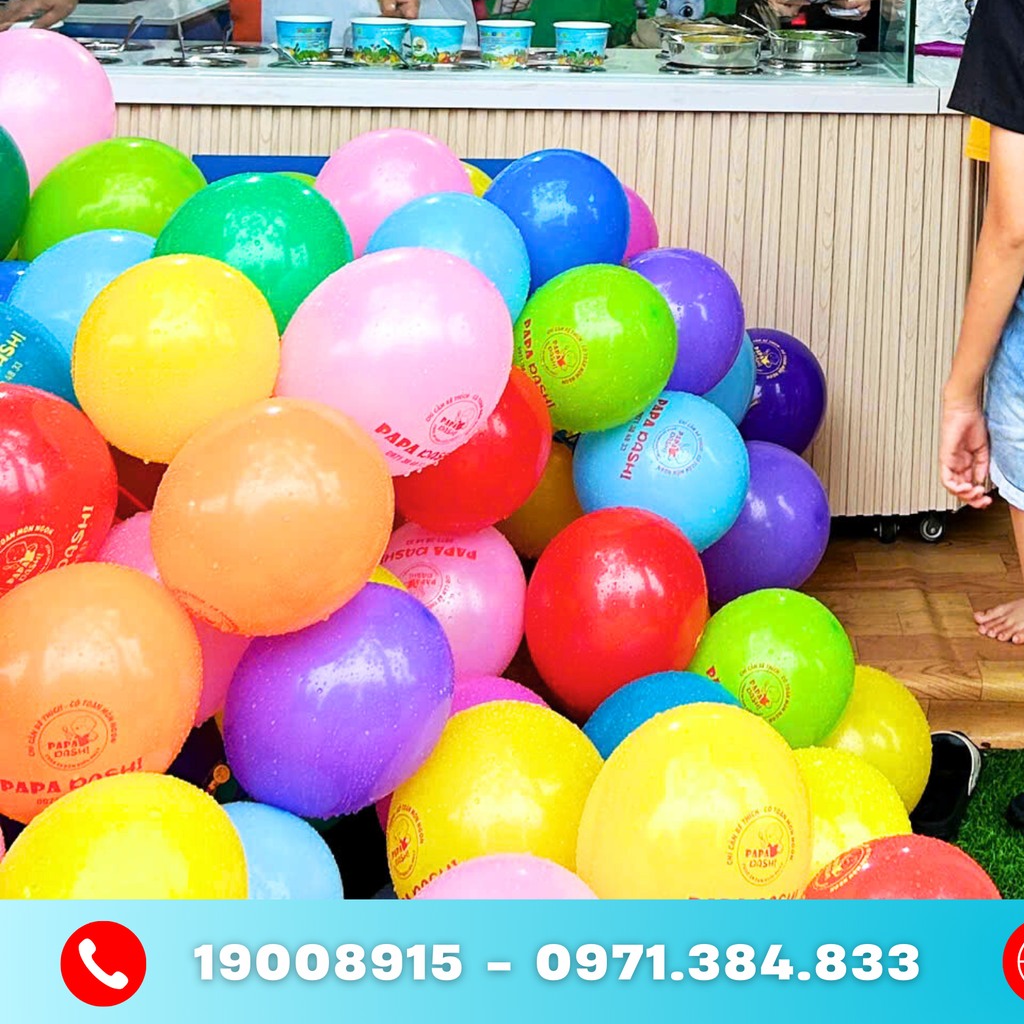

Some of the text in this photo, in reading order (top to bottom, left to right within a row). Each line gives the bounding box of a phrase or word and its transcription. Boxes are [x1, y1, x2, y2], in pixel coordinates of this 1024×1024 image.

[375, 422, 420, 455] PAPA
[620, 399, 669, 480] PAPA DASHI
[434, 546, 477, 560] PAPA
[47, 740, 78, 750] PAPA
[54, 746, 90, 757] DASHI
[0, 779, 61, 794] PAPA
[745, 849, 769, 858] PAPA
[749, 859, 777, 868] DASHI
